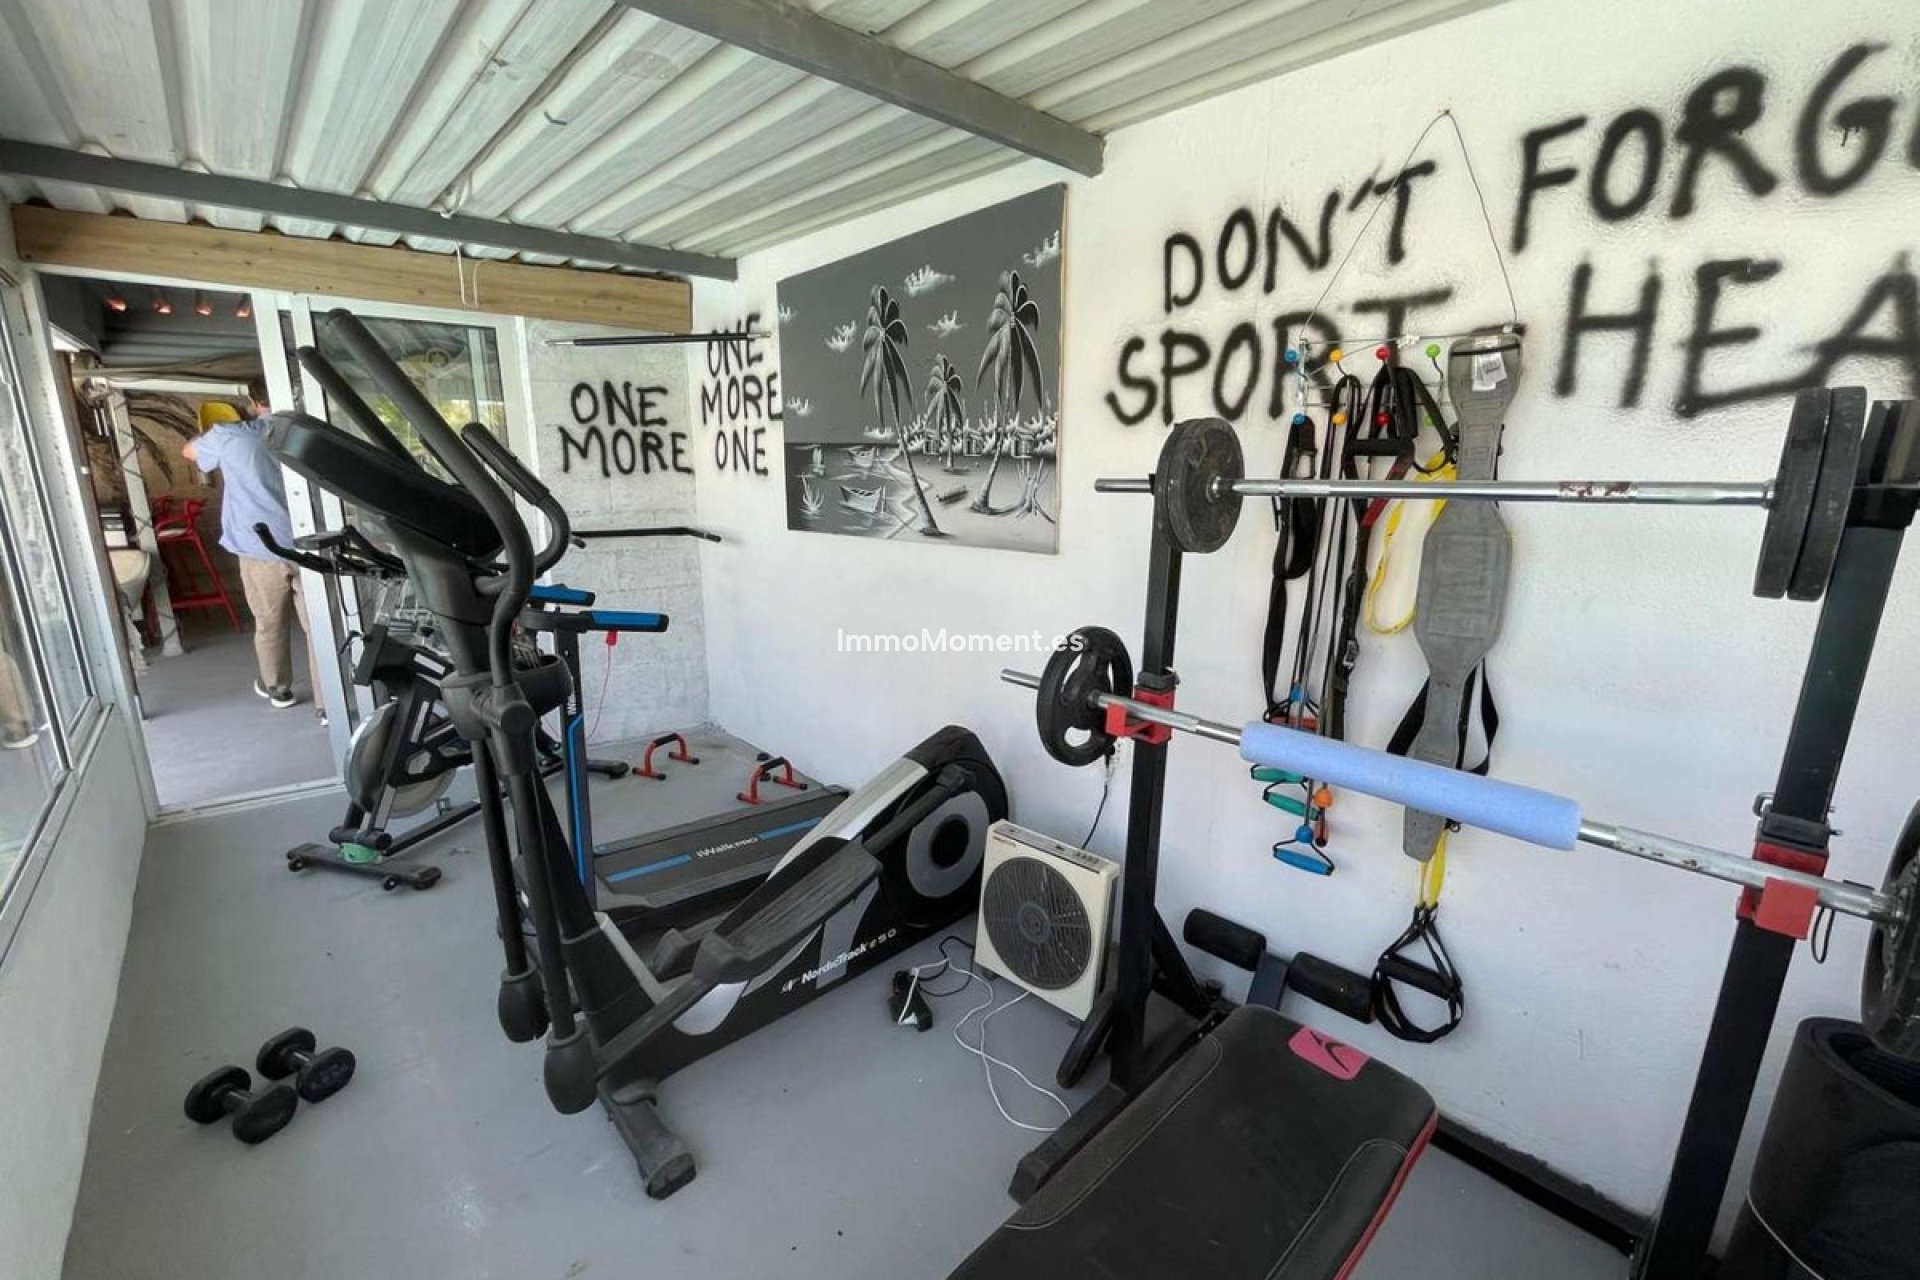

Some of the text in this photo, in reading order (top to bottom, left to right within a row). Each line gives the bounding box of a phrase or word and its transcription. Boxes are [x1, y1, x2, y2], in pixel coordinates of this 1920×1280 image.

[1162, 42, 1920, 314] DON'T FORG
[707, 311, 764, 378] ONE
[1105, 285, 1455, 427] SPORT
[570, 380, 668, 427] ONE
[701, 370, 783, 426] MORE
[557, 424, 695, 478] MORE
[715, 425, 769, 477] ONE
[800, 942, 868, 985] NordicTrack
